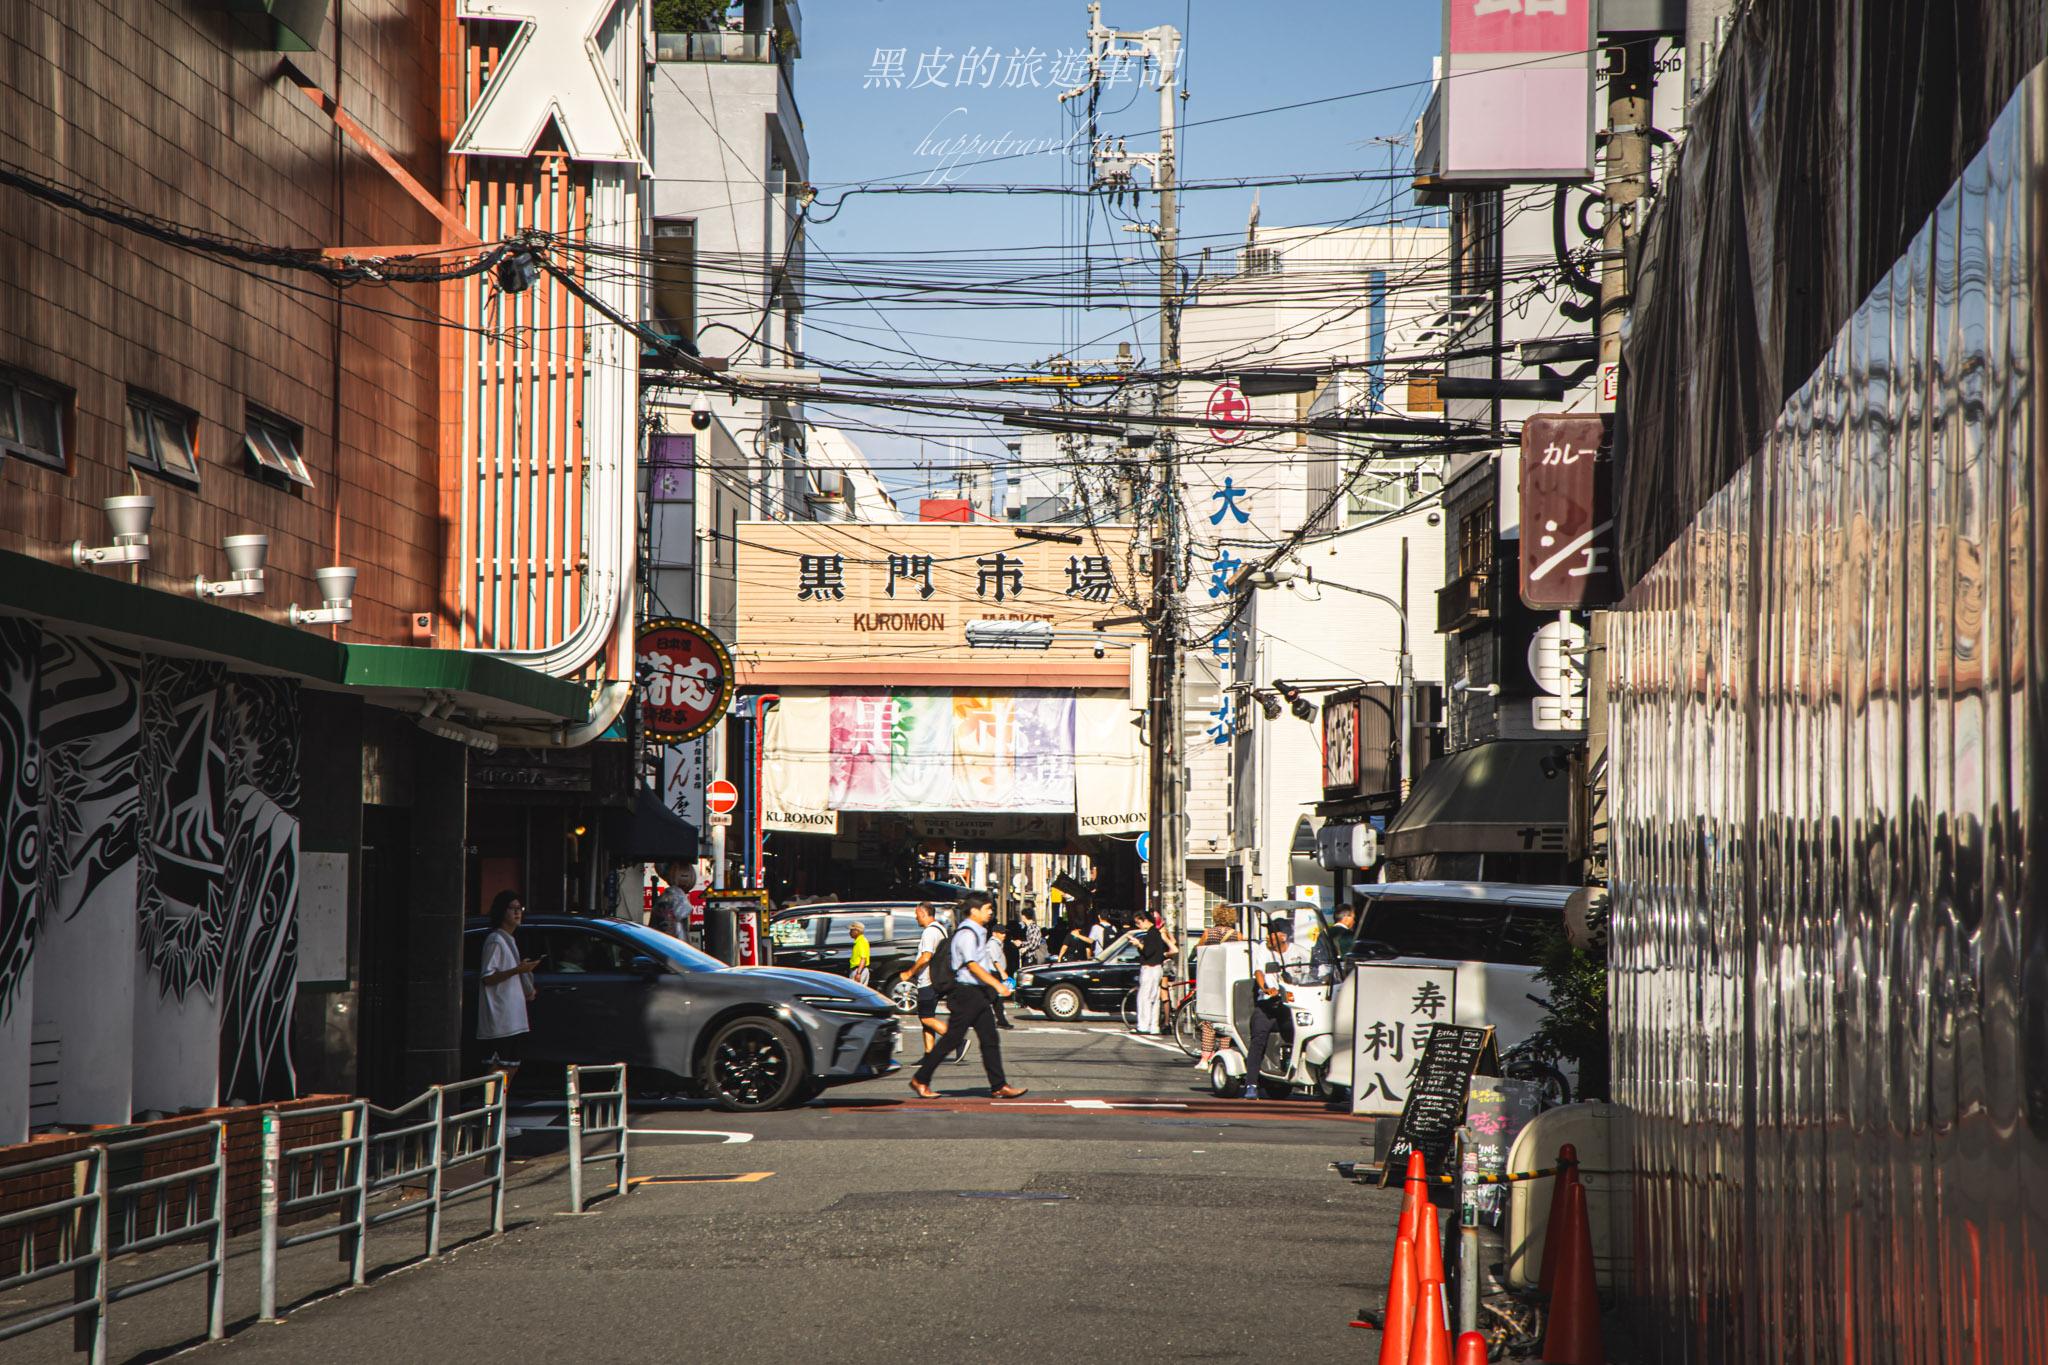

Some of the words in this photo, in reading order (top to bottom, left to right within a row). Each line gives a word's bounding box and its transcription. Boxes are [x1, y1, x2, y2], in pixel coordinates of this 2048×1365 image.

[797, 551, 1115, 602] 黒門市場
[853, 613, 945, 632] KUROMON
[766, 811, 834, 826] KUROMON
[1081, 812, 1147, 827] KUROMON
[1360, 1021, 1405, 1101] 利八
